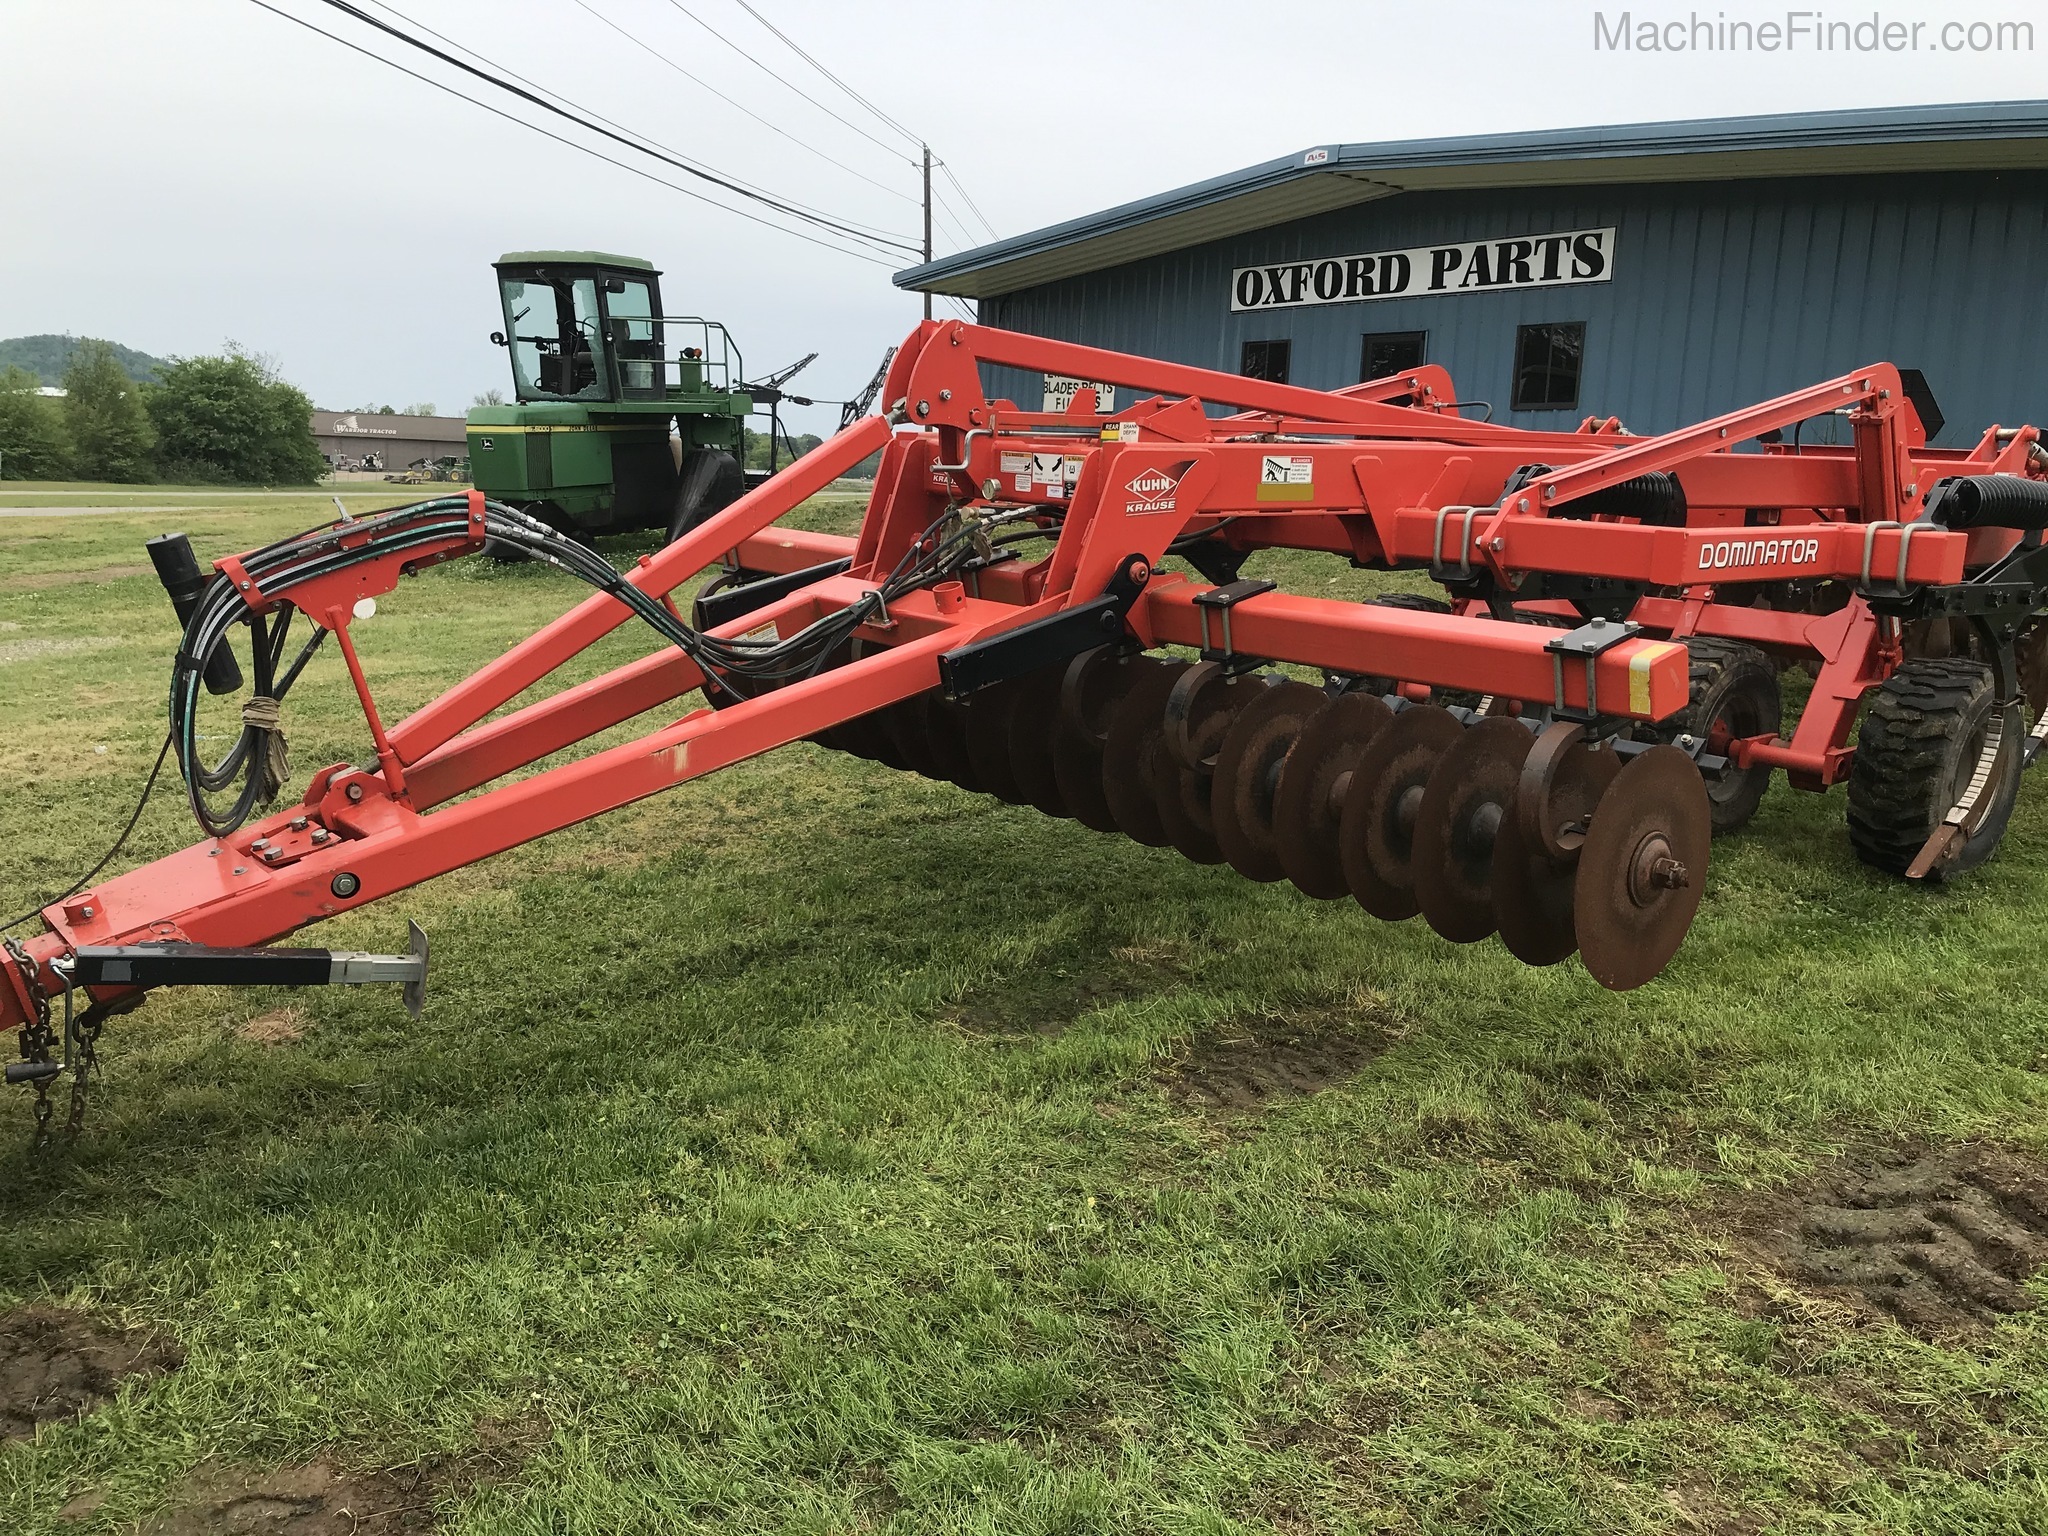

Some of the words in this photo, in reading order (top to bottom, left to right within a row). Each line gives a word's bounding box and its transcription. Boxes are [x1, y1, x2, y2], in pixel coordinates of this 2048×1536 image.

[1236, 253, 1411, 307] OXFORD
[1428, 233, 1605, 290] PARTS
[1044, 381, 1079, 395] BLADES
[336, 424, 368, 434] WARRIOR
[1105, 423, 1119, 431] REAR
[1132, 478, 1170, 492] KUHN
[1126, 501, 1175, 513] KRAUSE
[1698, 539, 1819, 569] DOMINATOR
